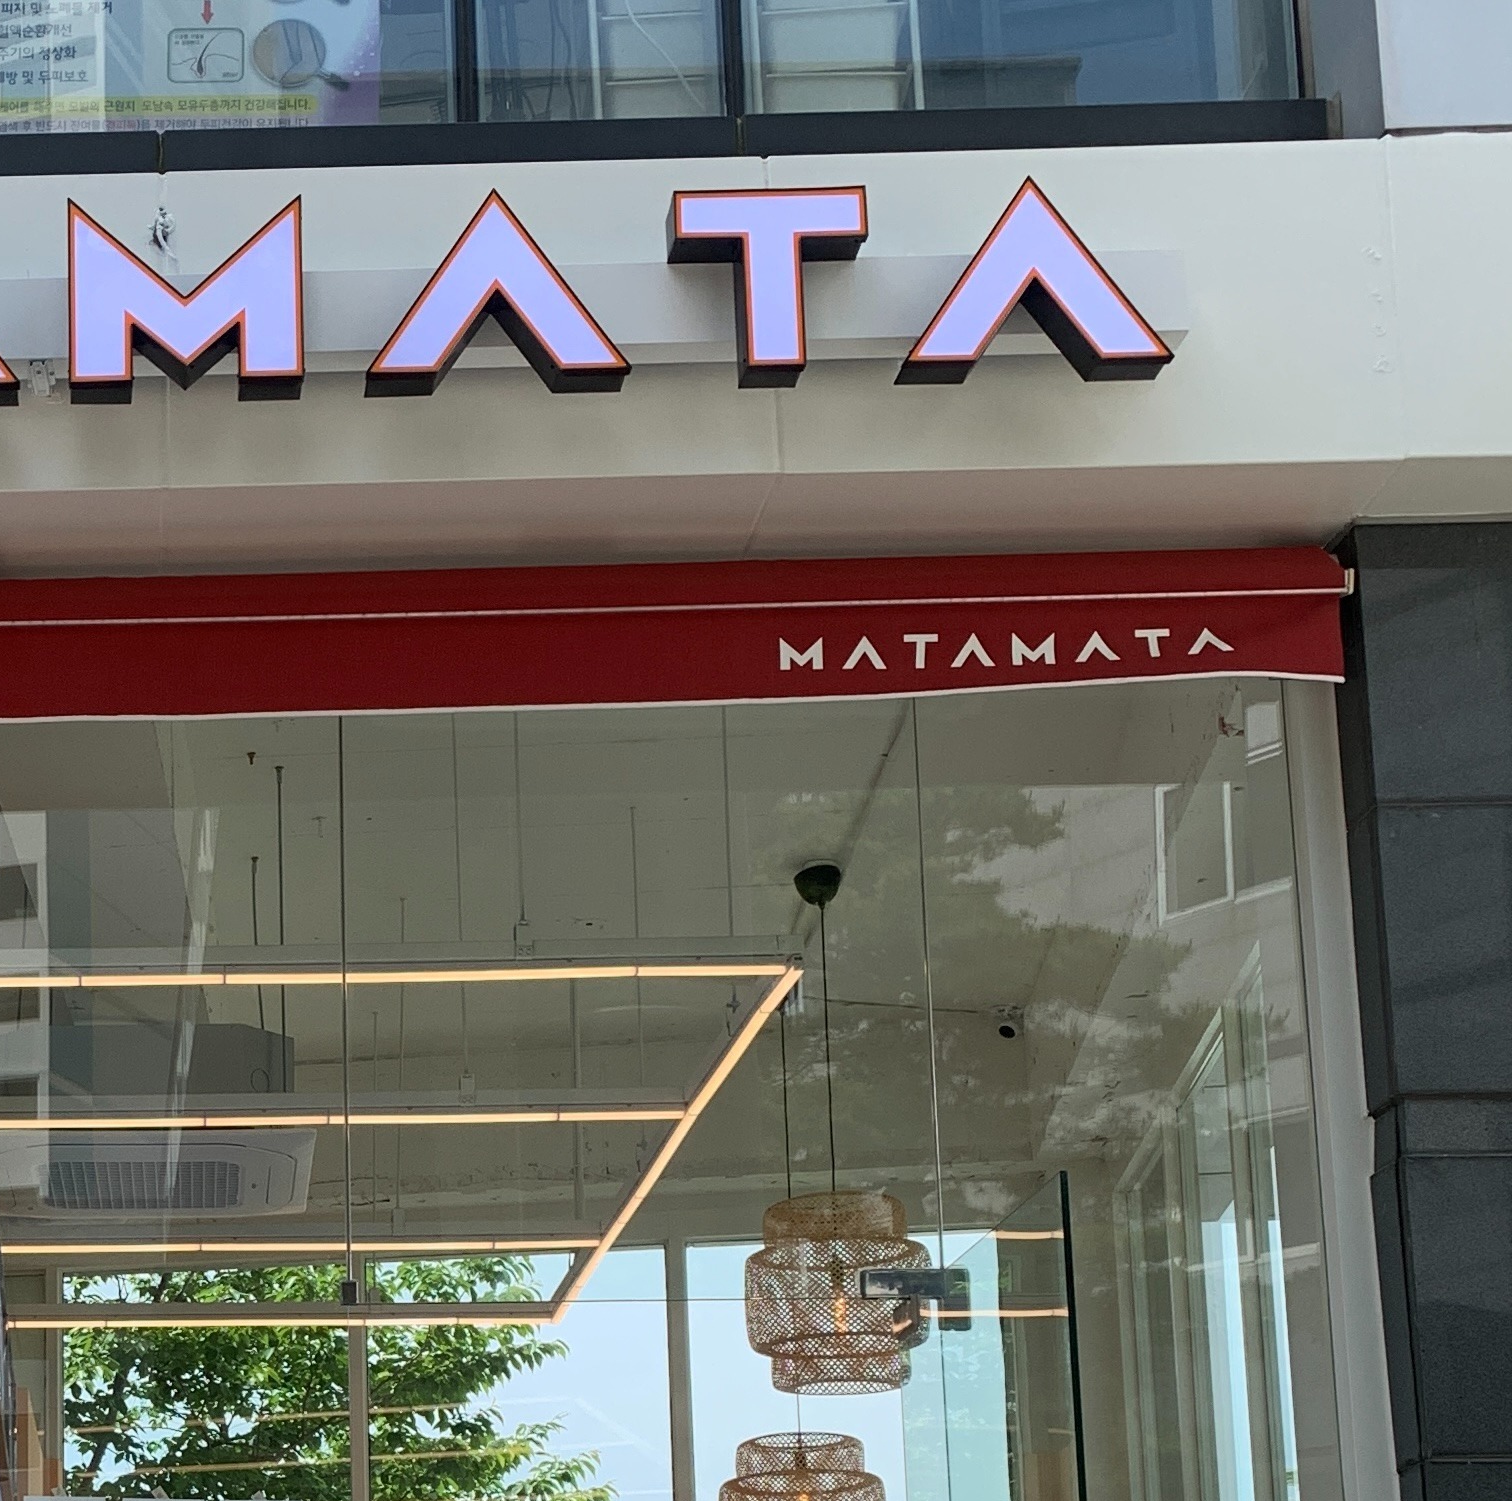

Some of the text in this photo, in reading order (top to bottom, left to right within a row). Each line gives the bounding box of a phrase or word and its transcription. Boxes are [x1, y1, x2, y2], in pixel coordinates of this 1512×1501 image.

[1, 2, 25, 15] 피지
[39, 45, 77, 60] 정상화
[22, 70, 34, 85] 및
[779, 627, 1235, 671] MATAMATA
